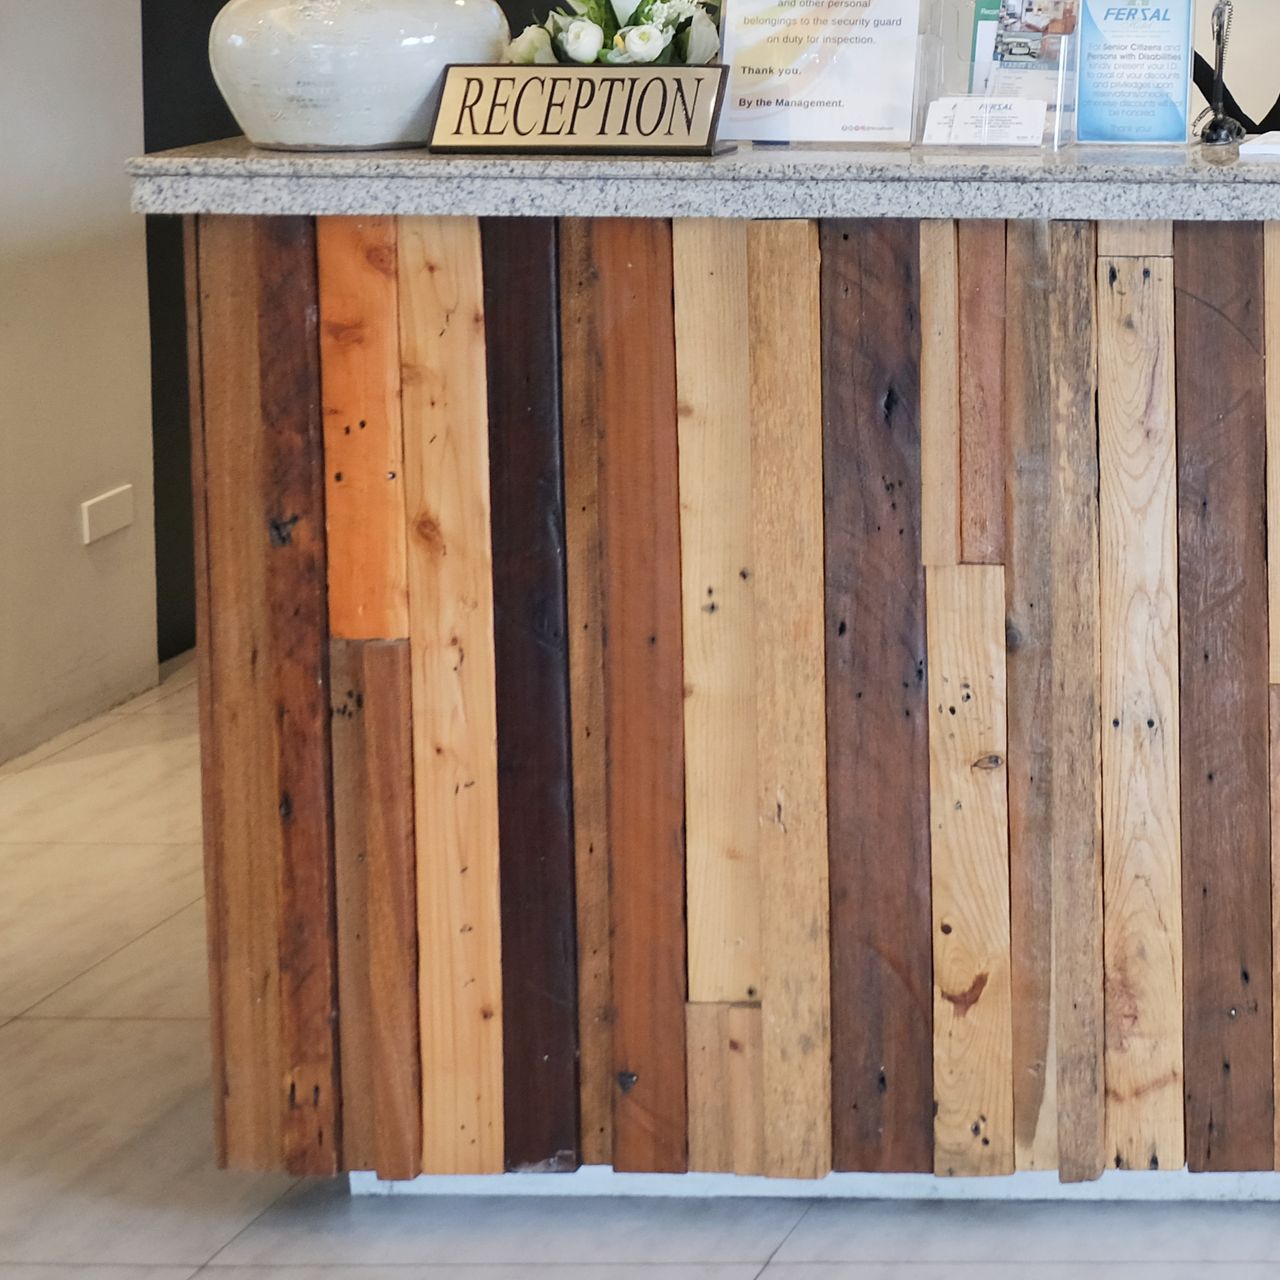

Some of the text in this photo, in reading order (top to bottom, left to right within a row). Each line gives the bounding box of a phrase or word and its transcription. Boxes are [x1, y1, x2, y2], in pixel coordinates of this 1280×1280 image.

[777, 0, 871, 9] and other personal
[1103, 8, 1171, 21] FERSAL
[743, 17, 902, 28] belongings to the security guard
[782, 35, 802, 46] duty
[806, 35, 820, 44] for
[822, 36, 876, 46] inspection.
[1103, 43, 1128, 51] Senior
[1130, 43, 1161, 51] Citizens
[1087, 52, 1117, 60] Persons
[1120, 52, 1136, 60] with
[741, 66, 801, 77] Thank you.
[452, 76, 705, 137] RECEPTION
[738, 98, 844, 109] By the Management.
